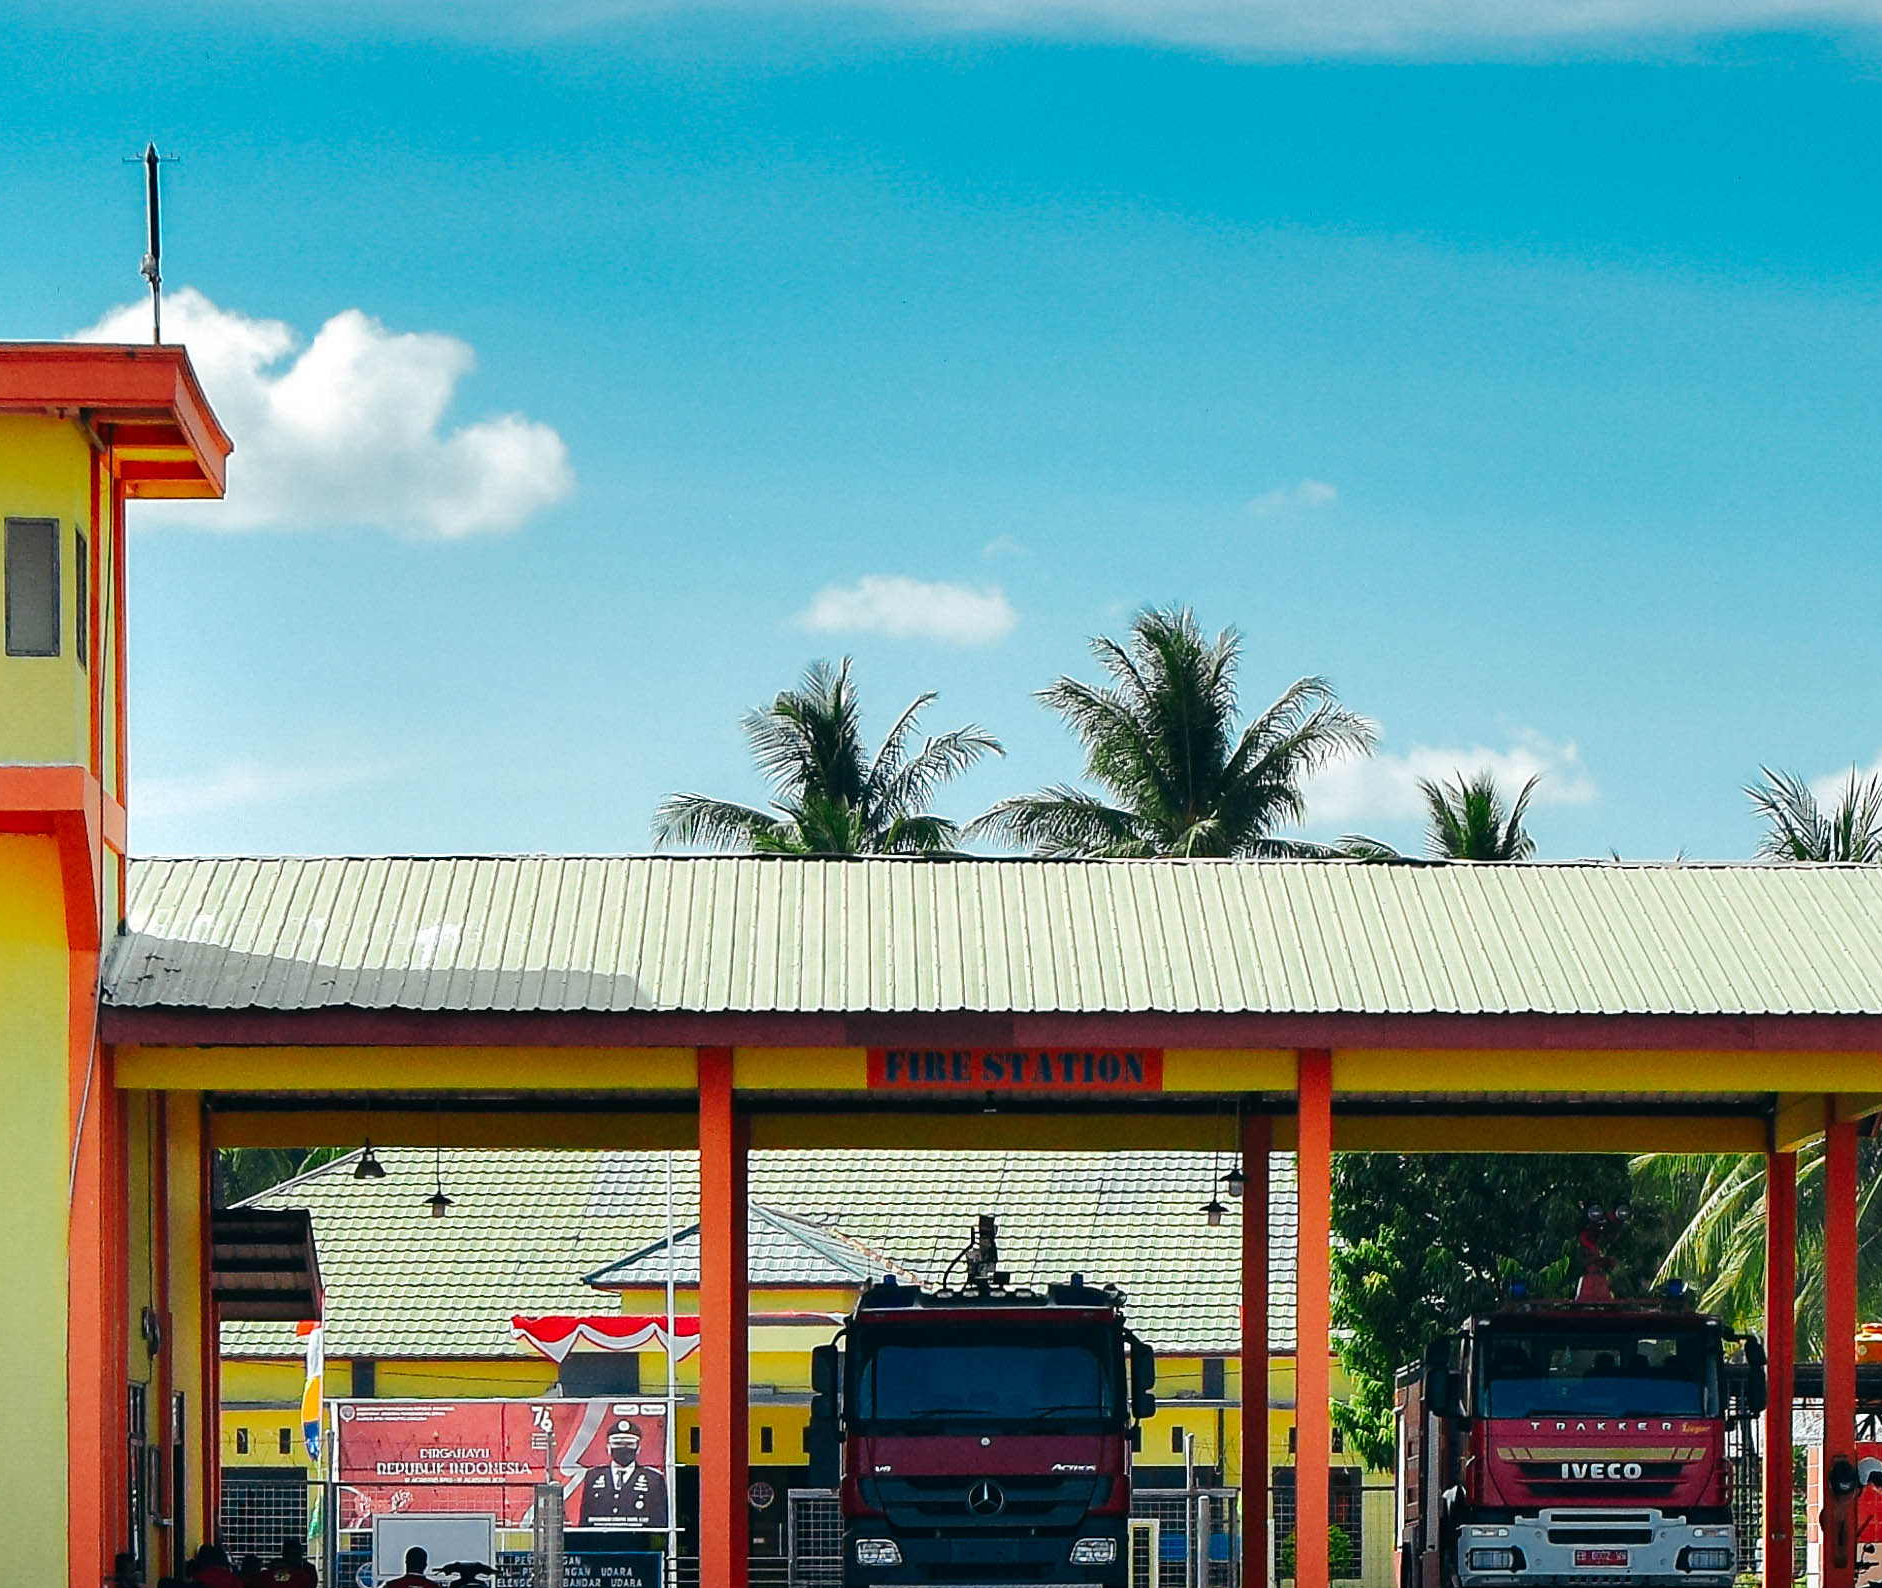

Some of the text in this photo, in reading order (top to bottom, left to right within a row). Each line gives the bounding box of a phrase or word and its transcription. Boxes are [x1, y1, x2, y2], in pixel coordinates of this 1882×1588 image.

[886, 1052, 1144, 1083] FIRE STATION
[1530, 1422, 1673, 1431] TRAKKER
[420, 1448, 490, 1459] DIRGAHAYU
[376, 1462, 533, 1475] REPUBLIK INDONESIA
[1561, 1463, 1642, 1479] IVECO
[601, 1567, 633, 1577] UDARA
[610, 1578, 643, 1588] UDARA
